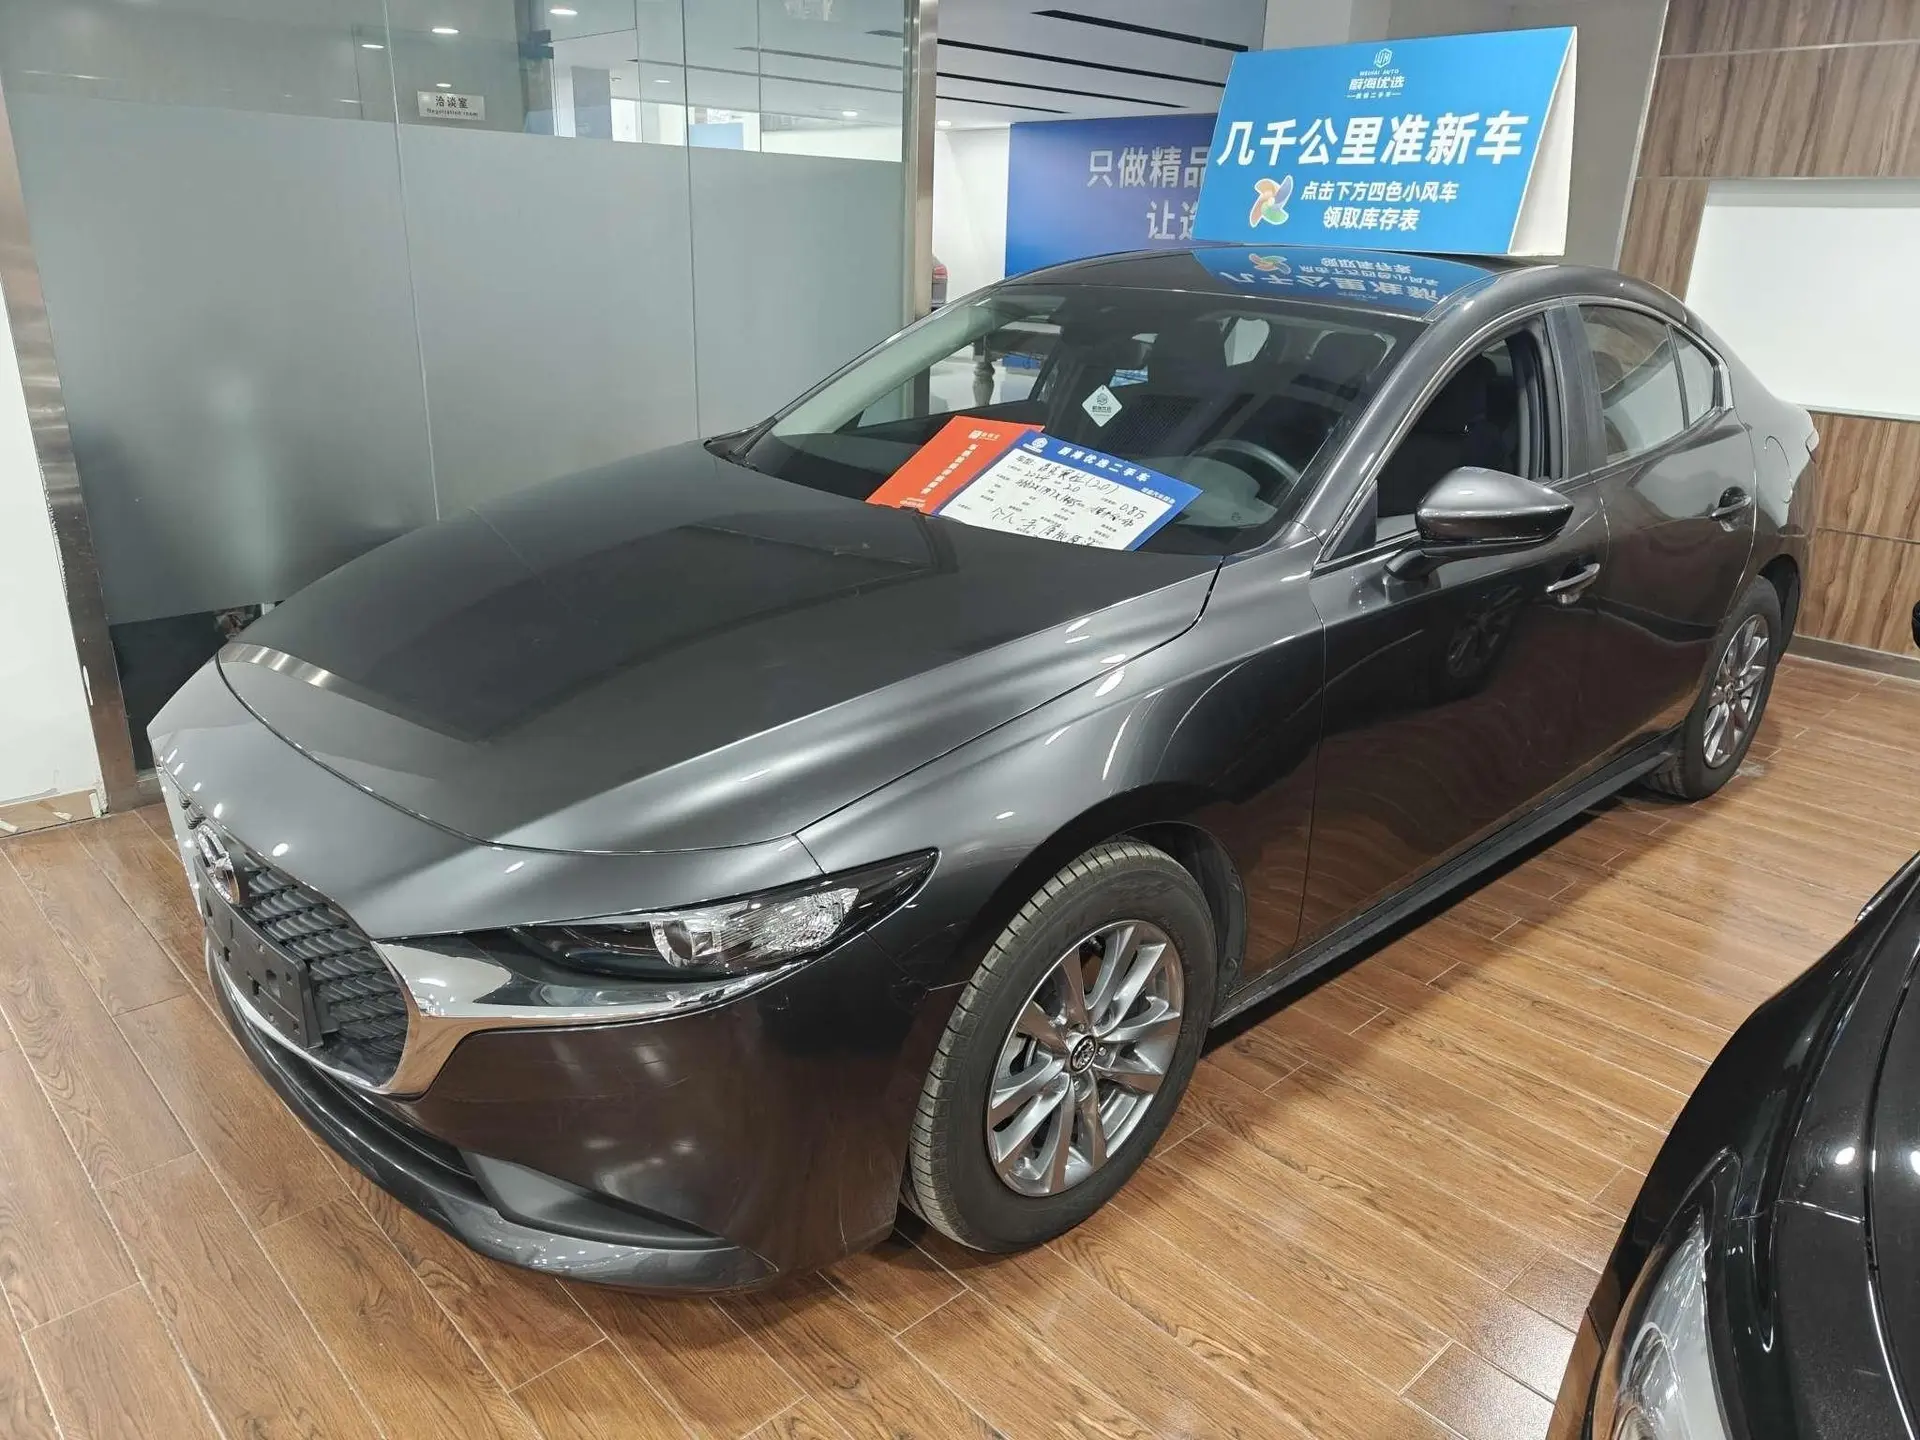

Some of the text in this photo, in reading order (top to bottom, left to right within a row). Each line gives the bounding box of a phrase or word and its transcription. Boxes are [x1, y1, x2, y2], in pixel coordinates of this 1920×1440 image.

[435, 95, 468, 108] 洽谈室
[1216, 110, 1529, 166] 几千公里准新车
[1087, 146, 1209, 188] 只做精品
[1300, 180, 1459, 203] 点击下方四色小风车
[1323, 206, 1421, 232] 领取库存表
